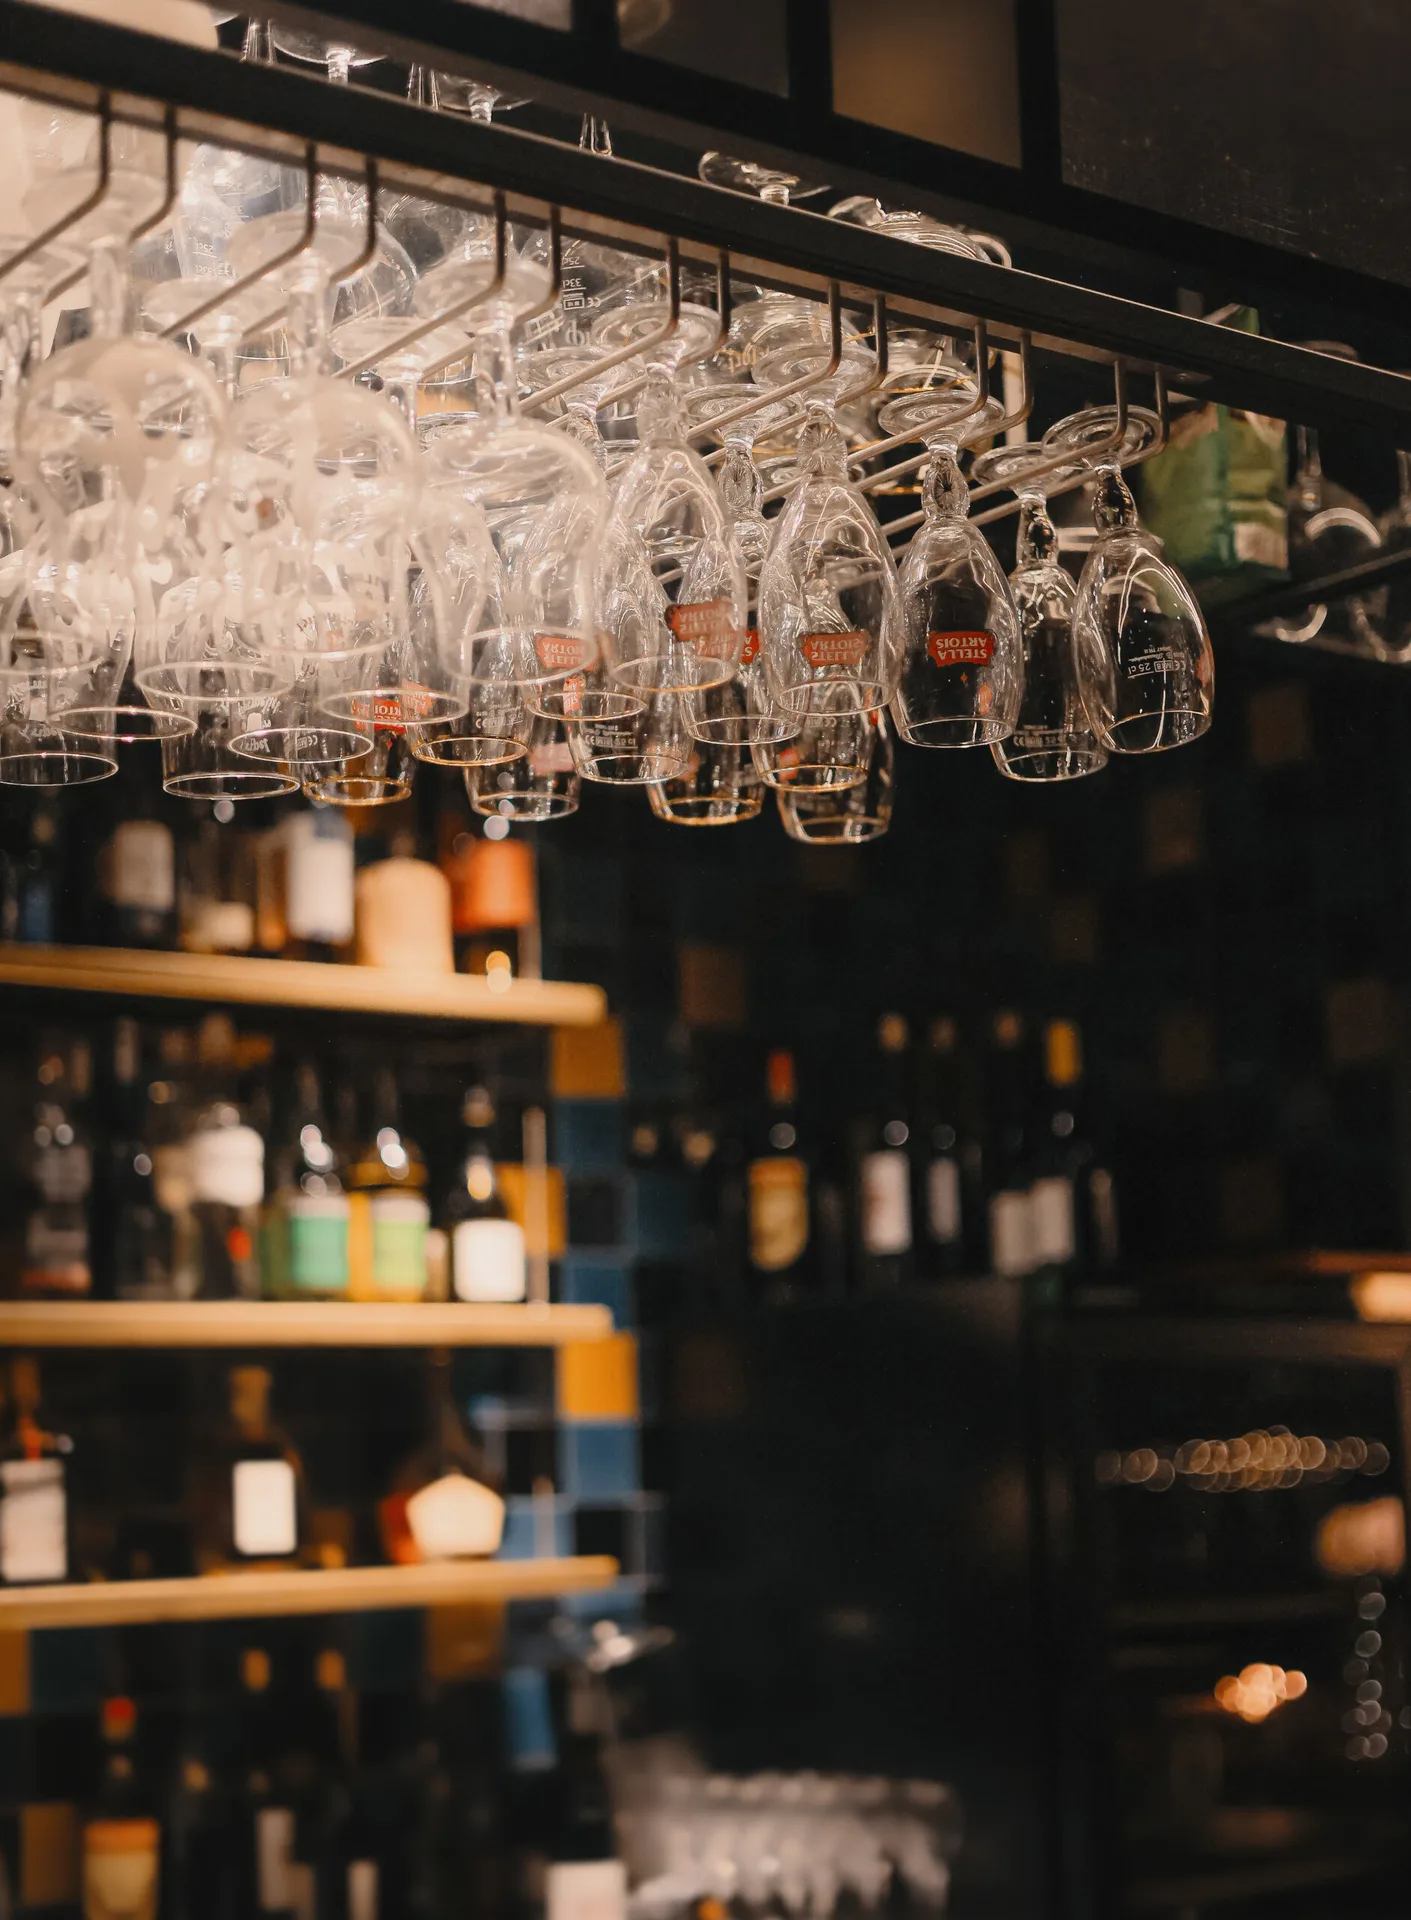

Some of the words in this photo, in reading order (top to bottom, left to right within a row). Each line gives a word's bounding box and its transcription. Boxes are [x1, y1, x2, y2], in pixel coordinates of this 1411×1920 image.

[196, 242, 214, 253] 25cl
[561, 255, 580, 266] 25cl
[562, 278, 582, 288] 33cl
[936, 637, 988, 649] ARTOIS
[937, 648, 988, 661] STELLA
[1128, 665, 1137, 675] cl
[1138, 662, 1151, 672] 25
